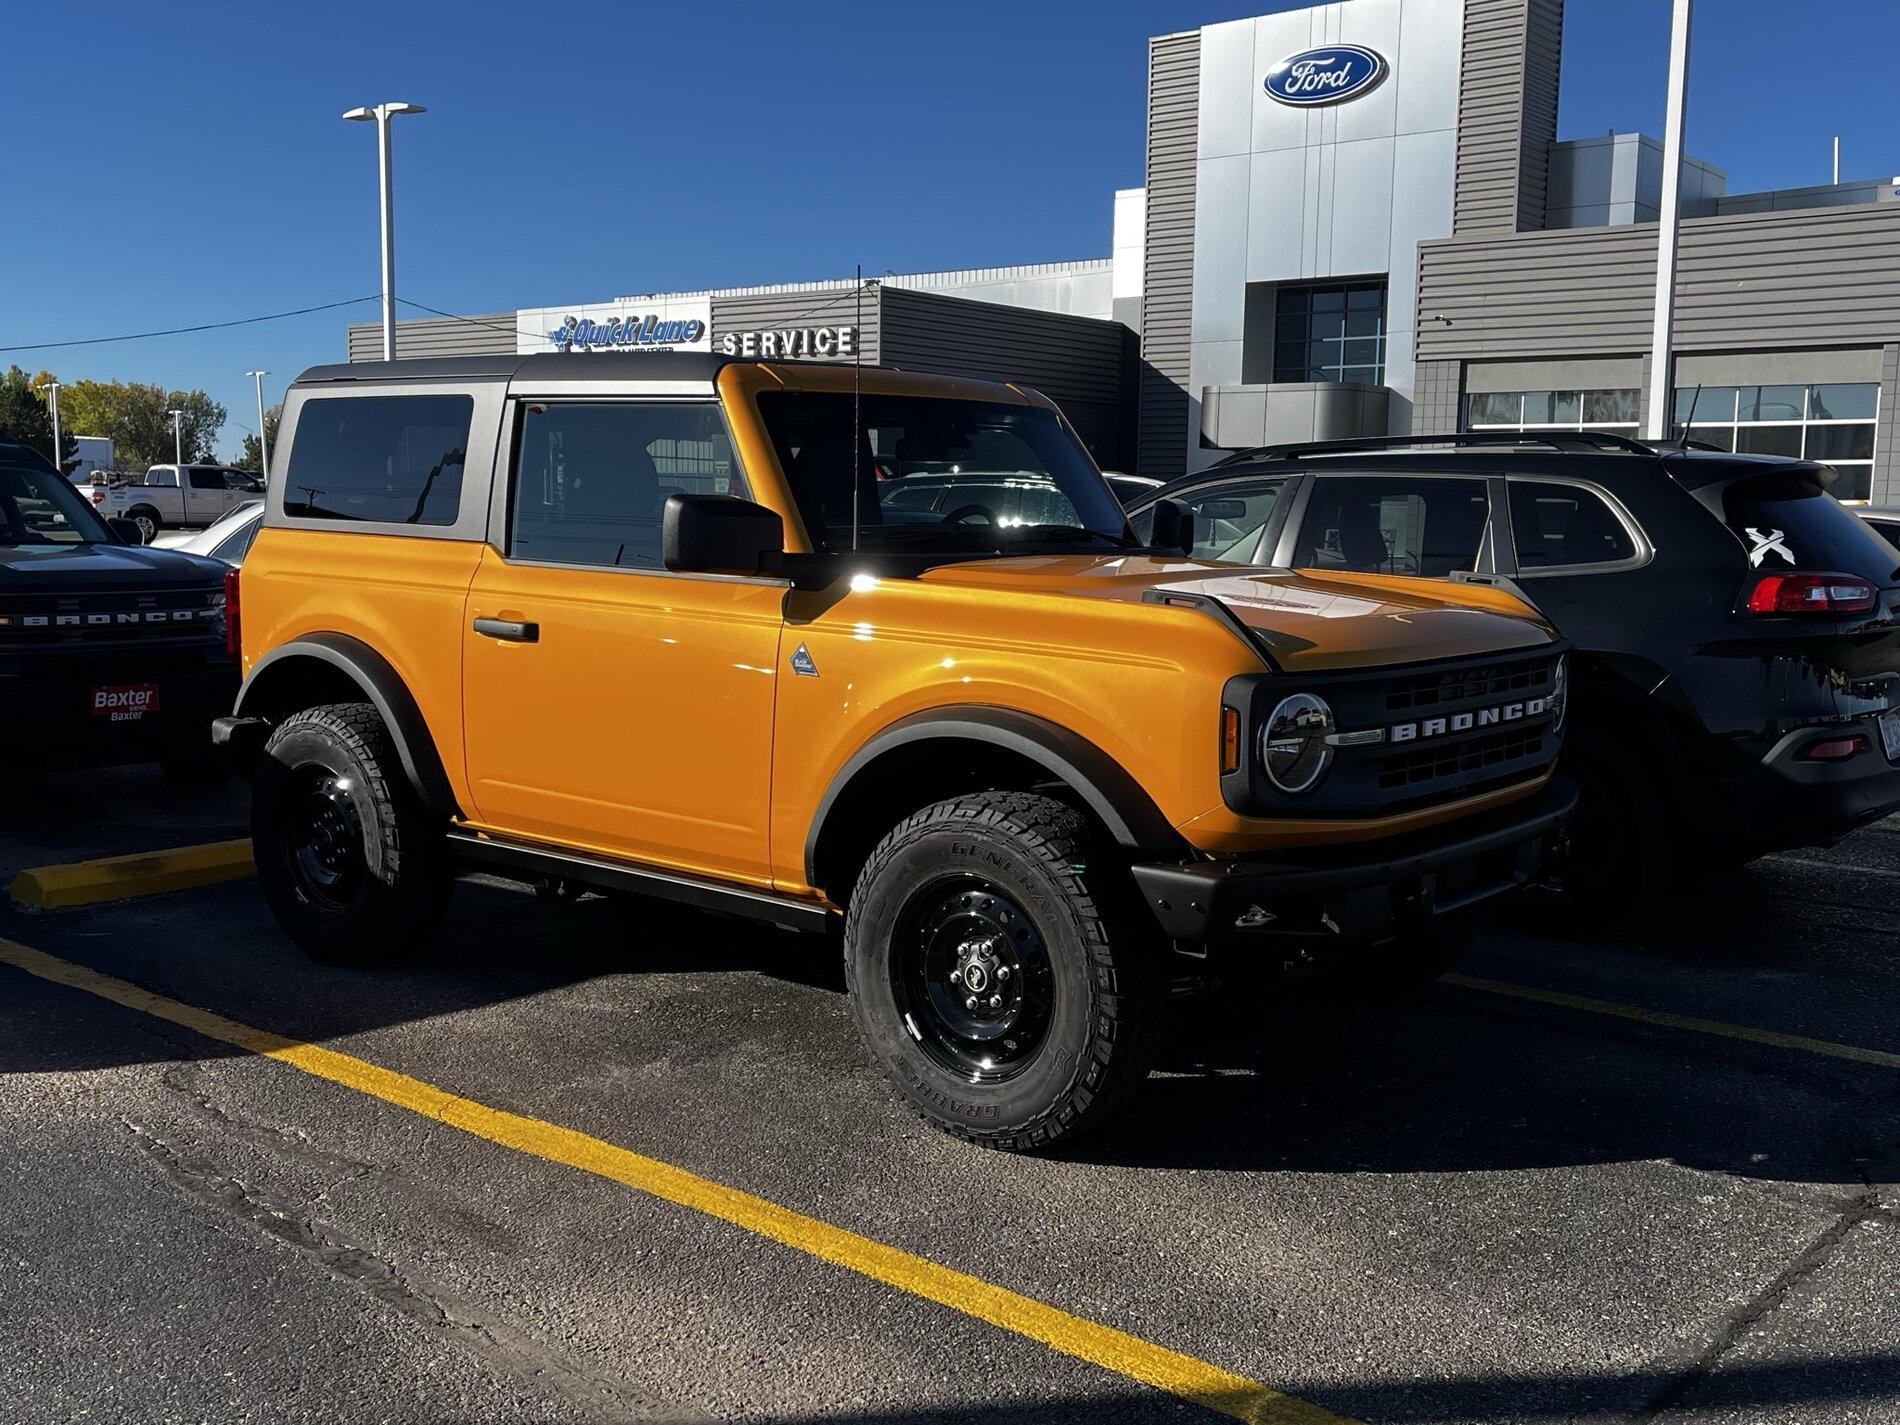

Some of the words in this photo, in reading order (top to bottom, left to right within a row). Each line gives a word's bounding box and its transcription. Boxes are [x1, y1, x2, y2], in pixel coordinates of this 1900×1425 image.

[1284, 57, 1353, 93] Ford
[572, 316, 638, 347] Quick
[637, 314, 700, 343] Lane
[722, 327, 853, 356] SERVICE
[23, 611, 193, 626] BRONCO
[95, 689, 153, 708] Baxter
[111, 711, 143, 722] Baxter
[1391, 698, 1544, 742] BRONCO
[951, 840, 1060, 934] GENERAL
